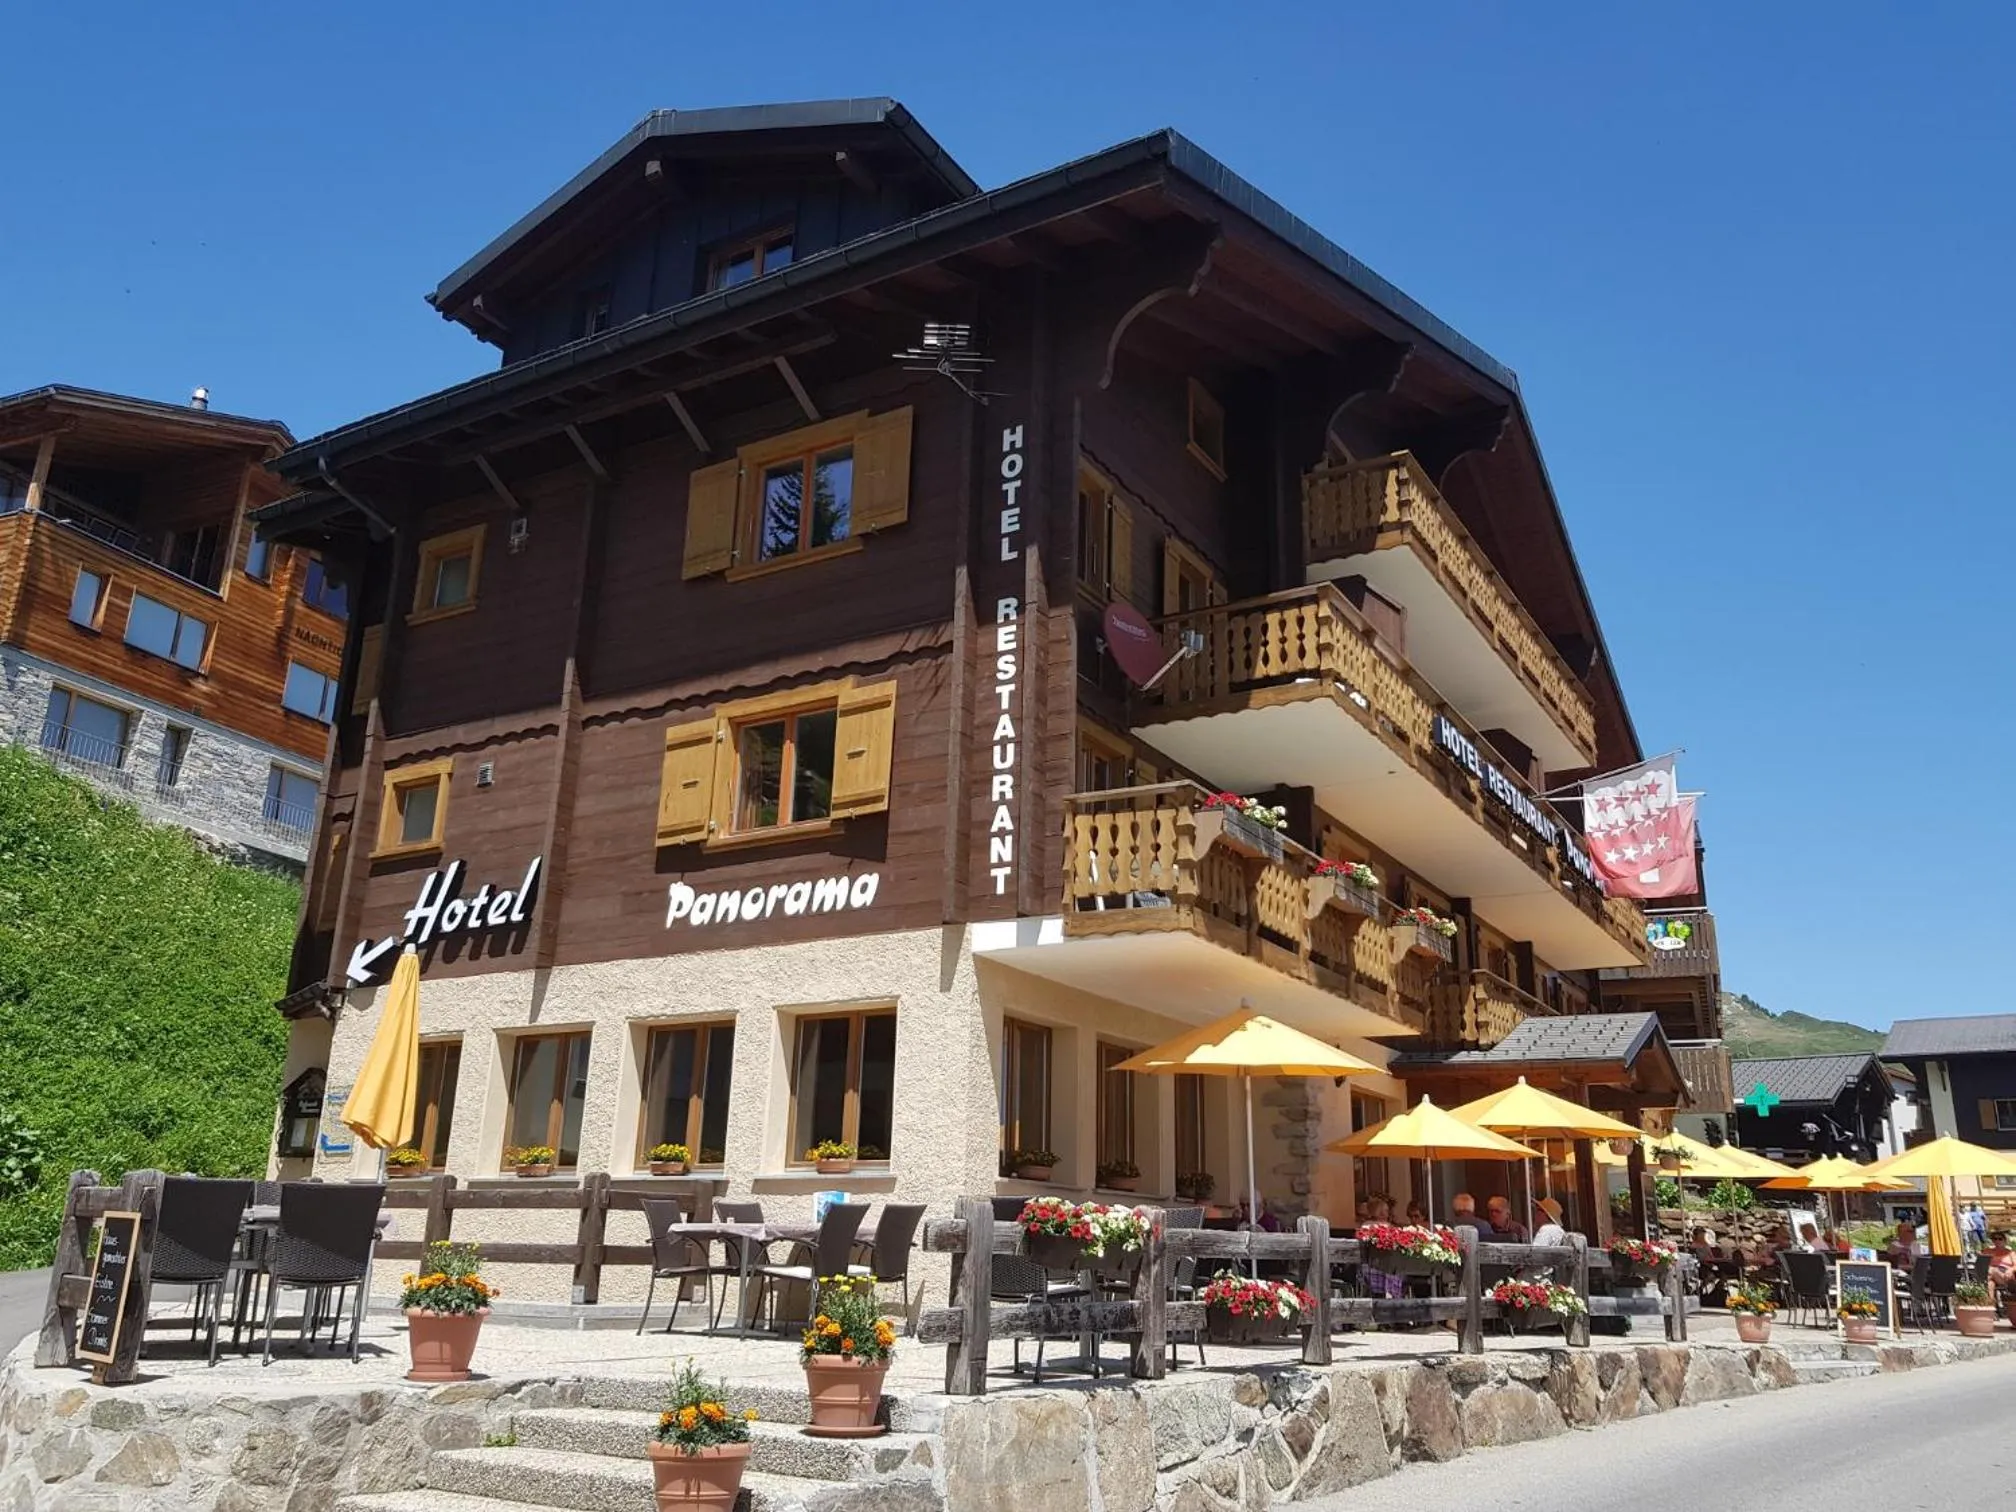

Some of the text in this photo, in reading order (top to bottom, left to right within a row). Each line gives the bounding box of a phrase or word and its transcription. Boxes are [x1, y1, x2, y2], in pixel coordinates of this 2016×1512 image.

[990, 424, 1024, 895] HOTEL RESTAURANT
[1441, 716, 1484, 778] HOTEL
[1487, 763, 1557, 847] RESTAURANT
[403, 855, 543, 944] Hotel
[666, 872, 880, 929] Panorama
